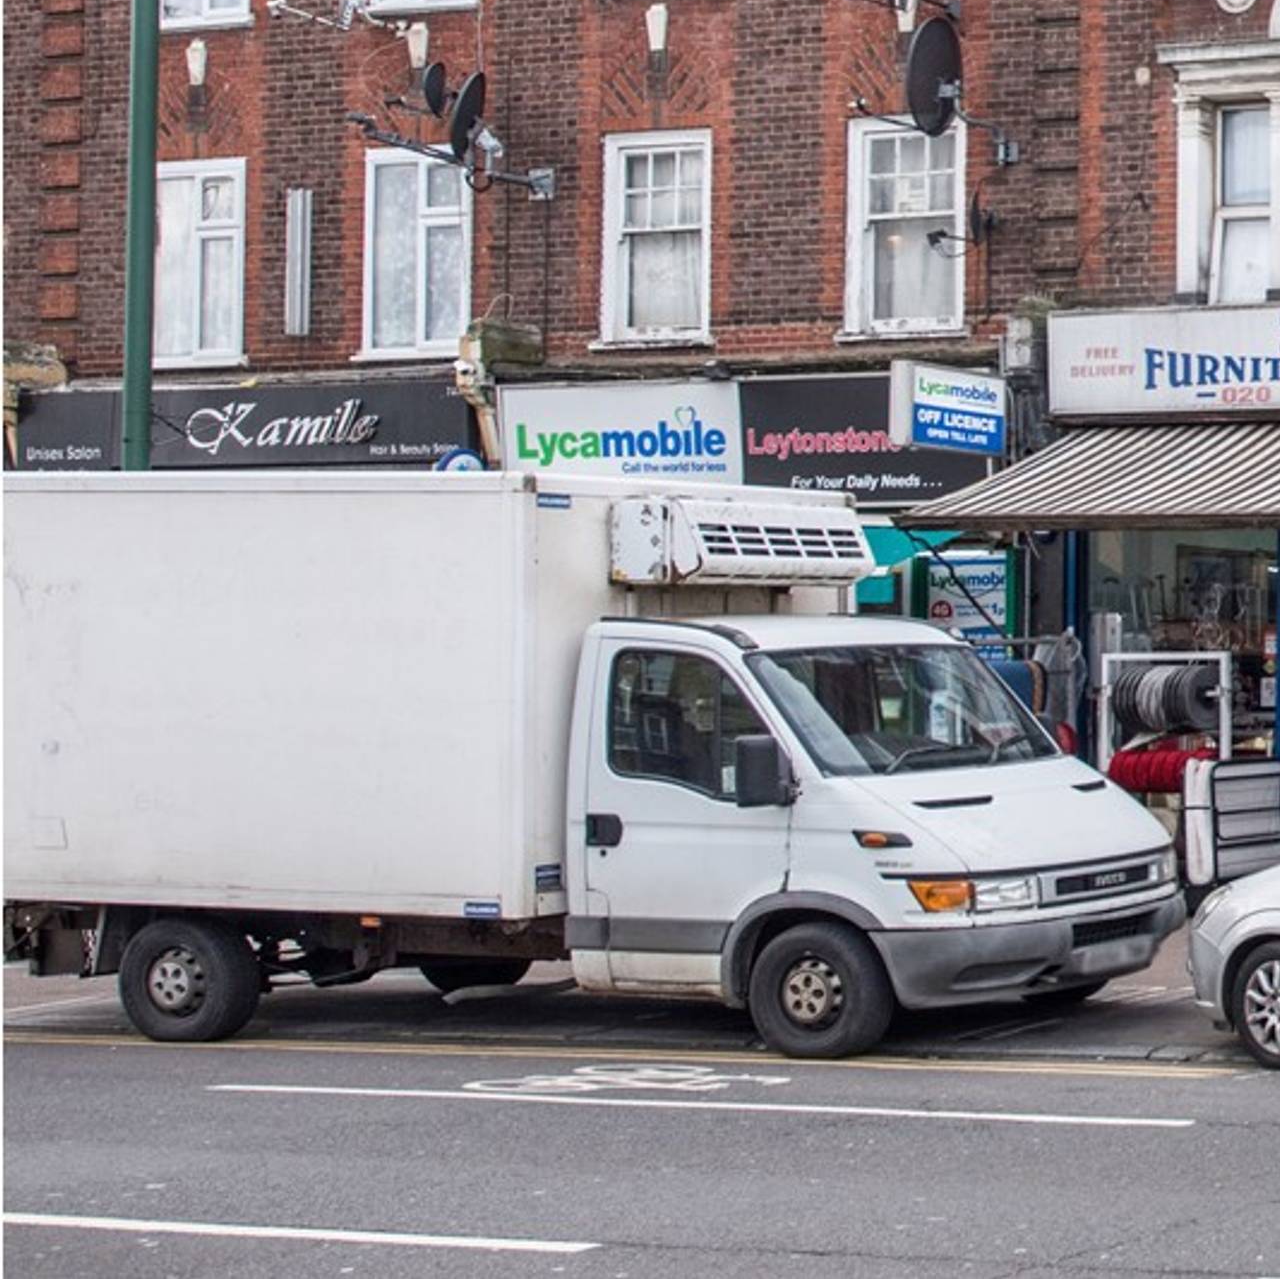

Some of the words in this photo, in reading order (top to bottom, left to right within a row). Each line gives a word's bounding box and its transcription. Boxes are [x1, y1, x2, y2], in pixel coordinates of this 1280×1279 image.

[1085, 347, 1119, 360] FREE
[1070, 364, 1136, 379] DELIVERY
[918, 376, 998, 403] Lycamobile
[1221, 386, 1272, 404] 020
[186, 397, 379, 455] Kamile
[917, 408, 942, 426] OFF
[944, 410, 998, 434] LICENCE
[516, 420, 727, 466] Lycamobile
[26, 445, 64, 461] Unisex
[67, 444, 102, 460] Salon
[621, 461, 641, 473] Call
[643, 461, 659, 473] the
[661, 461, 690, 473] world
[690, 461, 705, 473] for
[706, 461, 727, 473] less
[791, 474, 812, 488] For
[814, 473, 845, 489] Your
[847, 472, 879, 491] Daily
[880, 472, 921, 488] Needs
